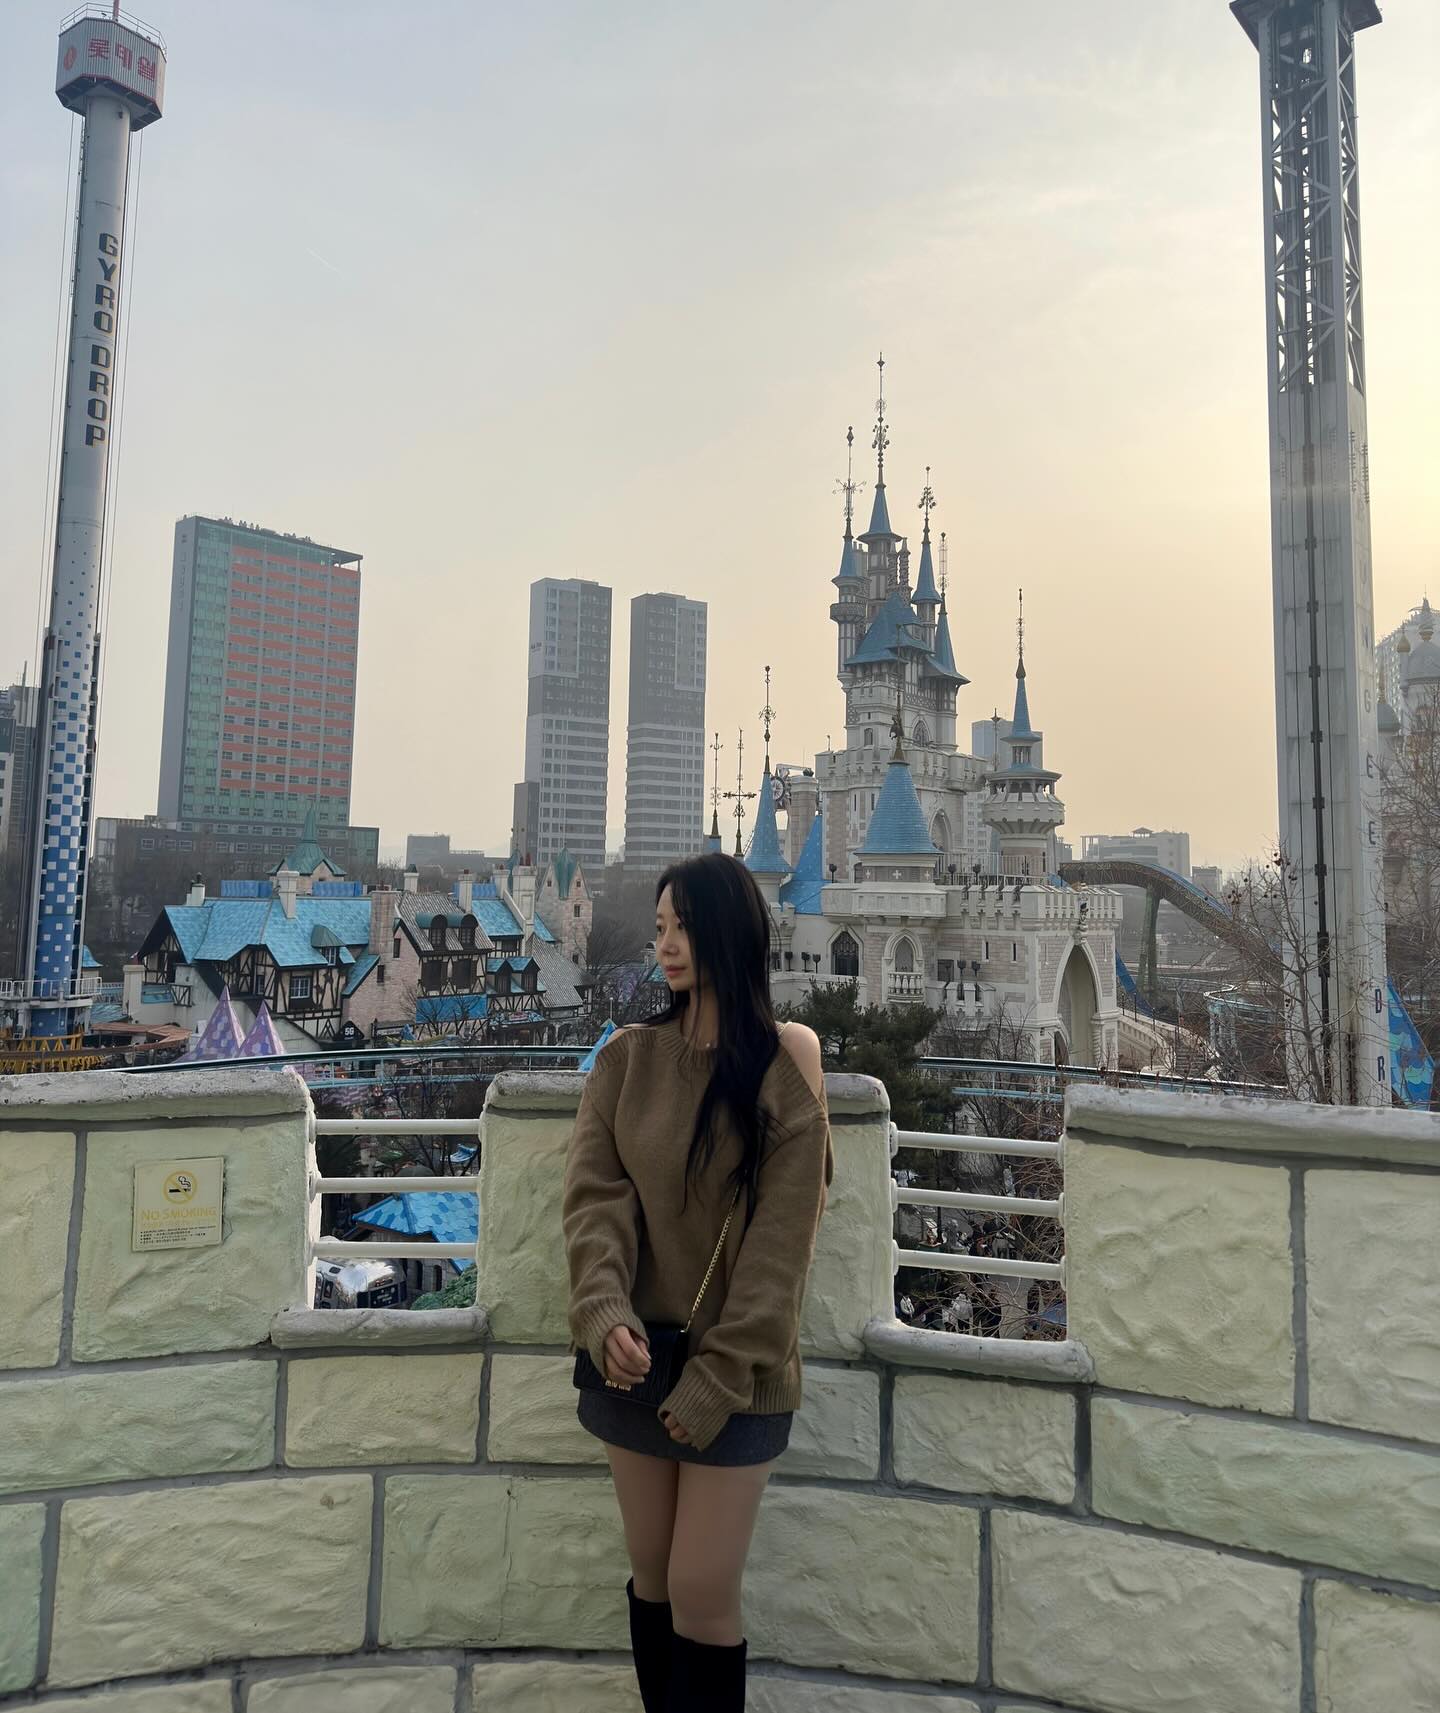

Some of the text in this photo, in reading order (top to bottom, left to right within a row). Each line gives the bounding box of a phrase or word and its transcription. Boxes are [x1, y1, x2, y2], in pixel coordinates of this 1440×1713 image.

[85, 232, 119, 446] GYRO DROP
[142, 1206, 217, 1220] NO SMOKING
